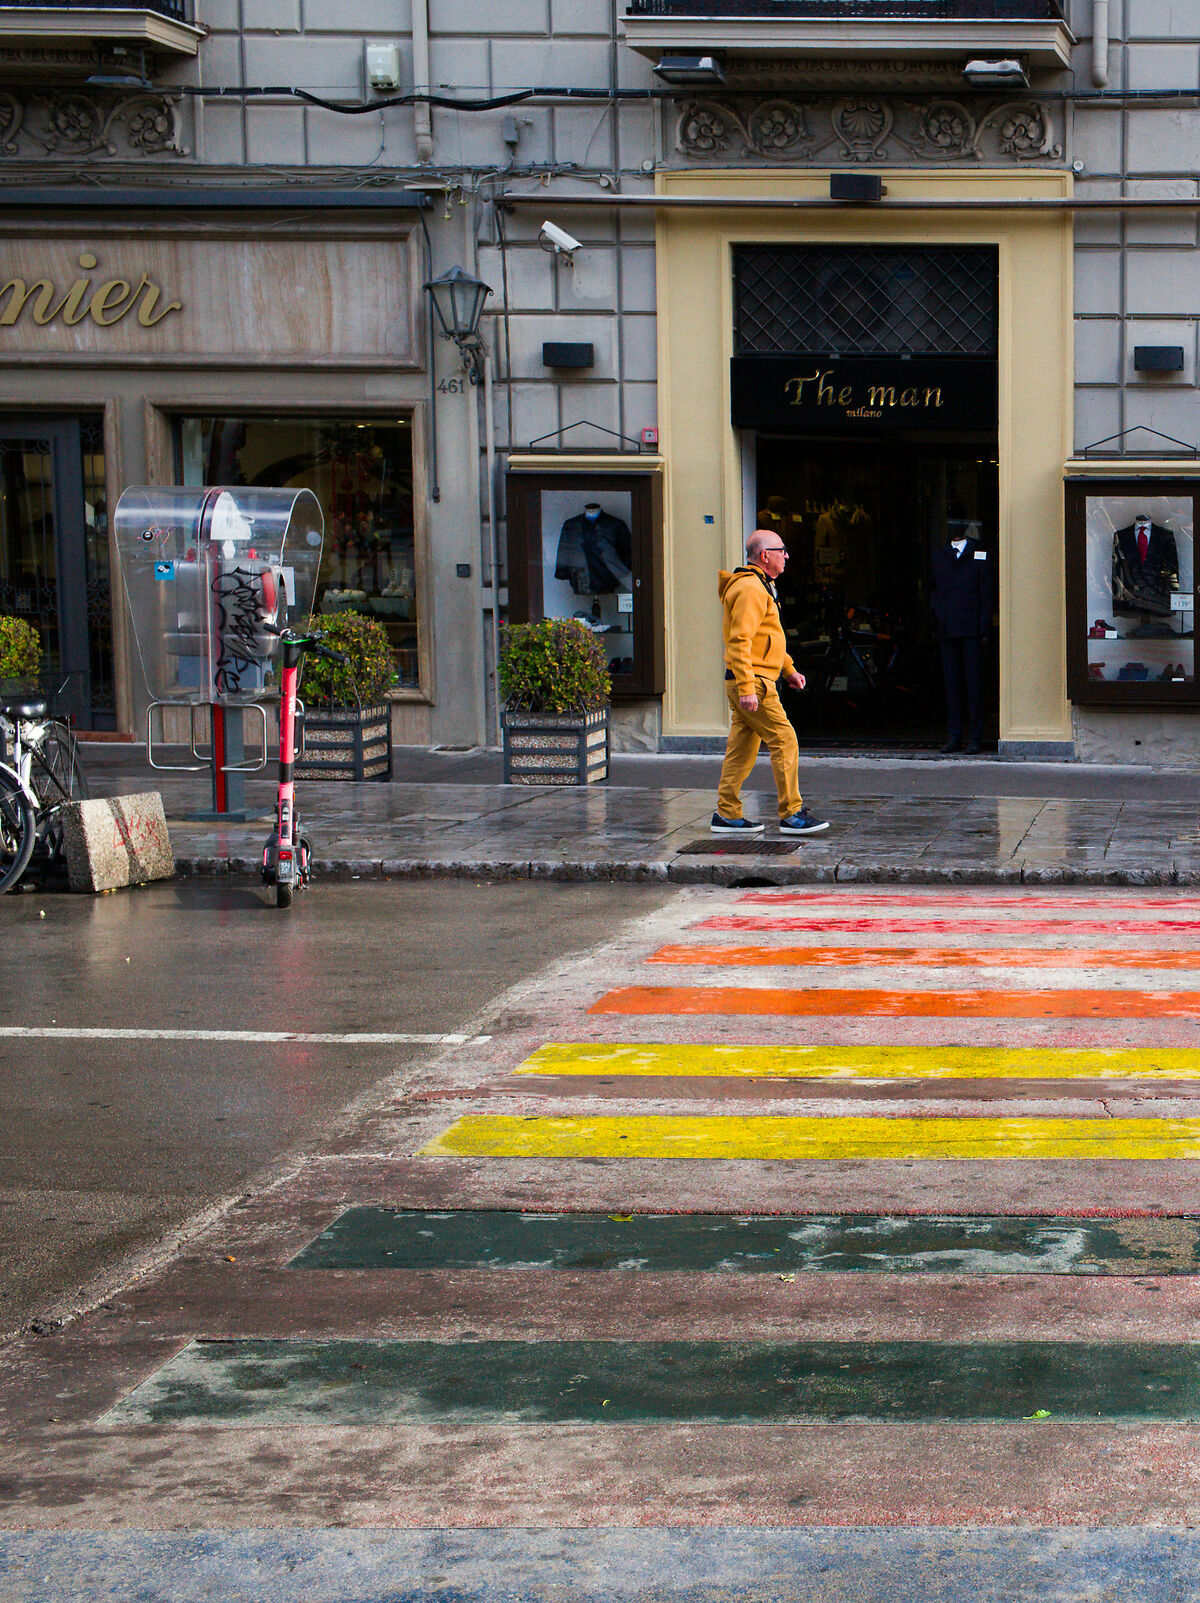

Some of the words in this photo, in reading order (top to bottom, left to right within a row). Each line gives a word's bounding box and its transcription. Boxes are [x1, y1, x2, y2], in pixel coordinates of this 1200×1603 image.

[437, 379, 465, 393] 461
[784, 369, 853, 406] The
[867, 386, 944, 407] man
[846, 405, 882, 418] milano
